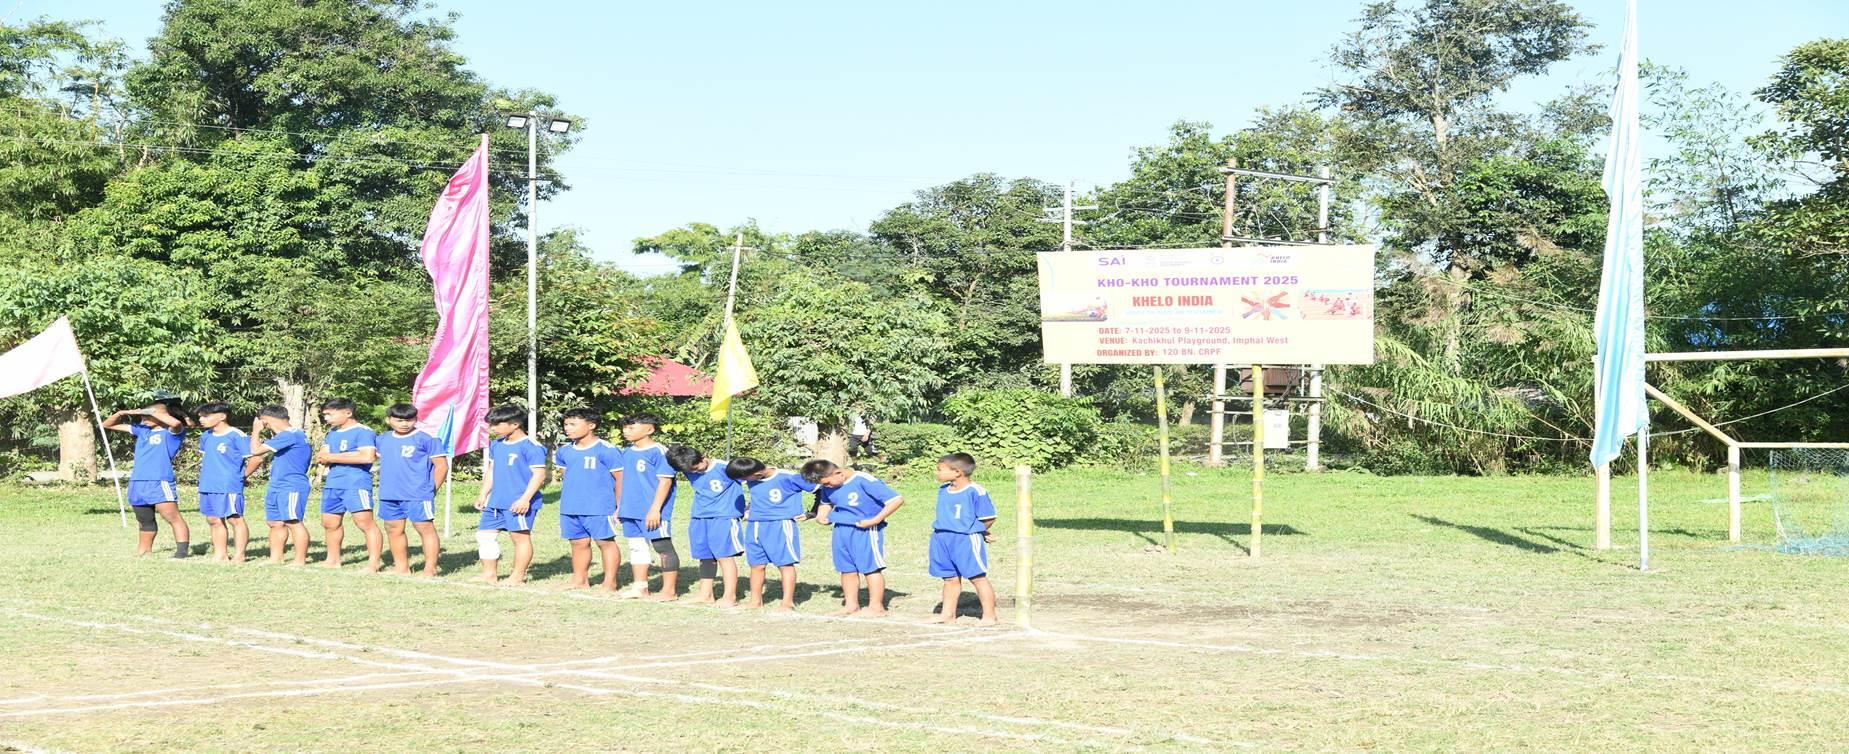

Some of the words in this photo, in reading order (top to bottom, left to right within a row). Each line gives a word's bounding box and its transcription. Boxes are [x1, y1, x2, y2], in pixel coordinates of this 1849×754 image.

[1097, 277, 1159, 287] KHO-KHO
[1164, 276, 1259, 286] TOURNAMENT
[1263, 275, 1299, 285] 2025
[1132, 295, 1174, 307] KHELO
[1177, 295, 1214, 306] INDIA
[1098, 327, 1122, 335] DATE:
[1125, 327, 1170, 335] 7-11-2025
[1173, 327, 1182, 335] to
[1184, 326, 1231, 334] 9-11-2025
[1099, 337, 1128, 345] VENUE:
[1233, 336, 1264, 346] Imphal
[1266, 336, 1289, 344] West
[1096, 349, 1142, 357] ORGANIZED
[1162, 348, 1179, 356] 120
[1198, 347, 1222, 356] CRPF
[401, 445, 416, 458] 12
[508, 453, 518, 466] 7
[584, 456, 597, 469] 11
[636, 459, 646, 472] 6
[709, 479, 724, 493] 8
[768, 488, 782, 504] 9
[847, 491, 859, 507] 2
[954, 503, 962, 519] 1
